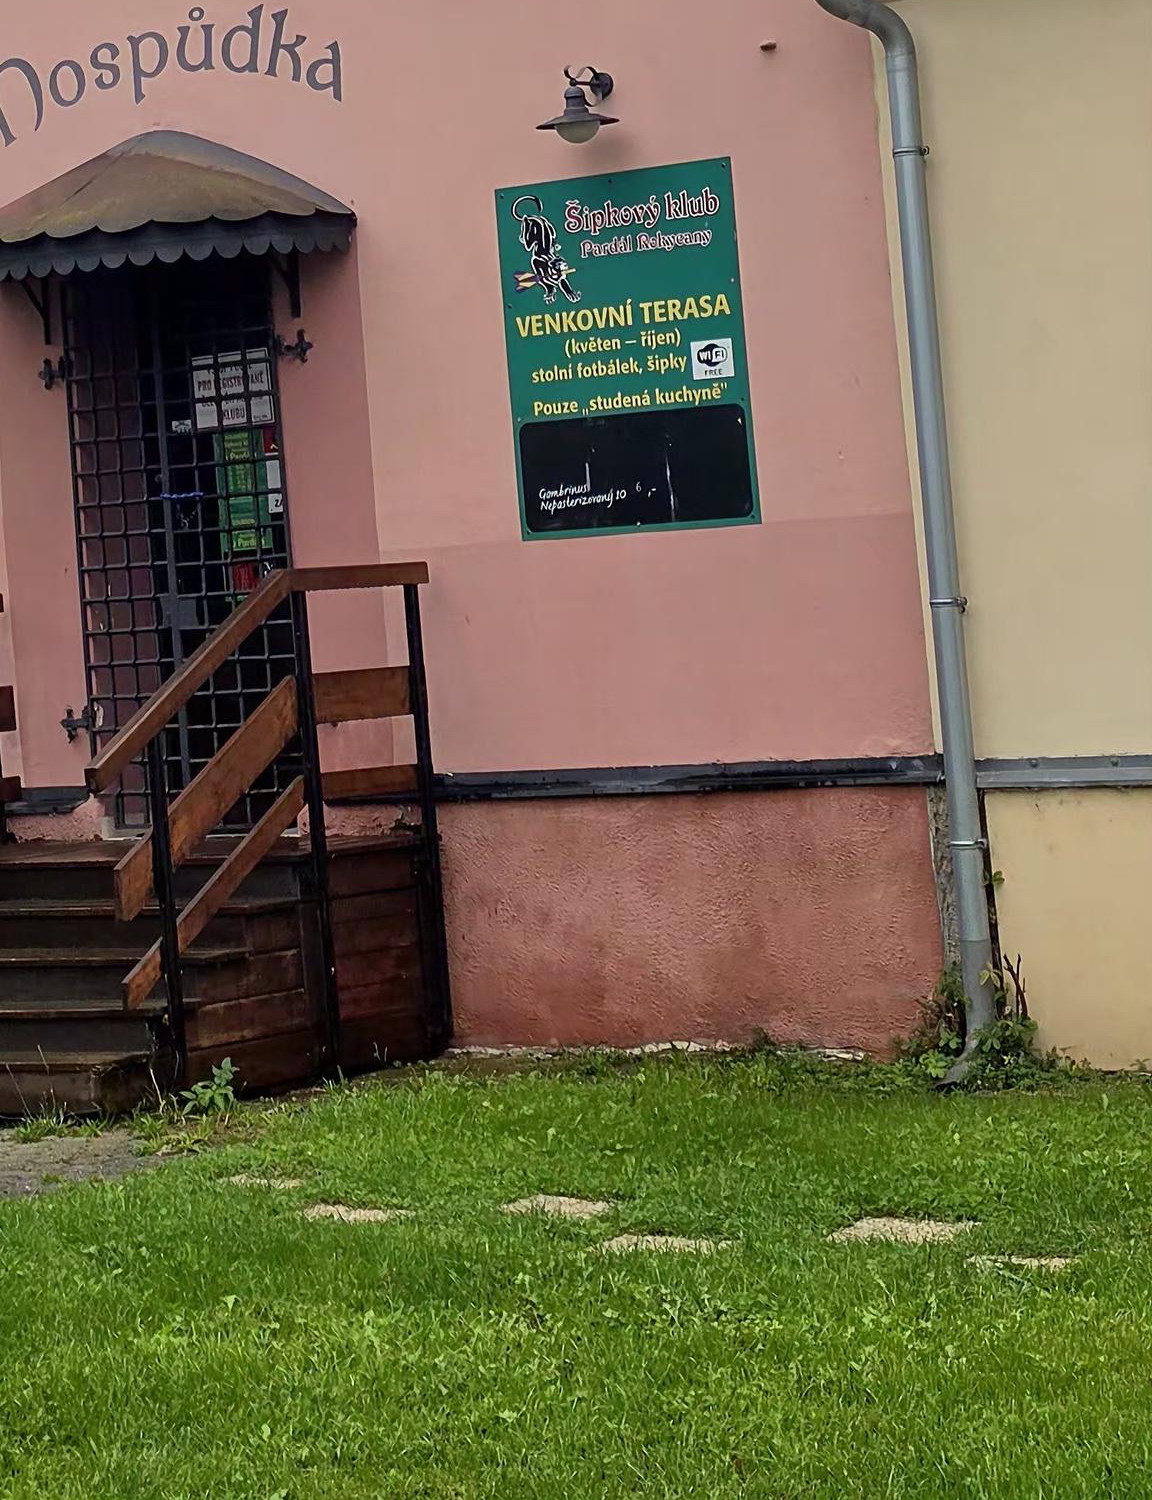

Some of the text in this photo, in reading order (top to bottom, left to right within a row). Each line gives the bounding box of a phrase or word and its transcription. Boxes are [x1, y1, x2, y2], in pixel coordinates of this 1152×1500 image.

[564, 186, 720, 236] Šipkový klub
[581, 229, 713, 258] Pardál Rokycany
[515, 293, 731, 338] VENKOVNÍ TERASA
[564, 336, 621, 358] (květen
[640, 328, 681, 350] říjen)
[532, 353, 687, 383] stolní fotbálek, šipky
[704, 368, 723, 376] FREE
[533, 397, 579, 417] Pouze
[616, 489, 627, 500] 10
